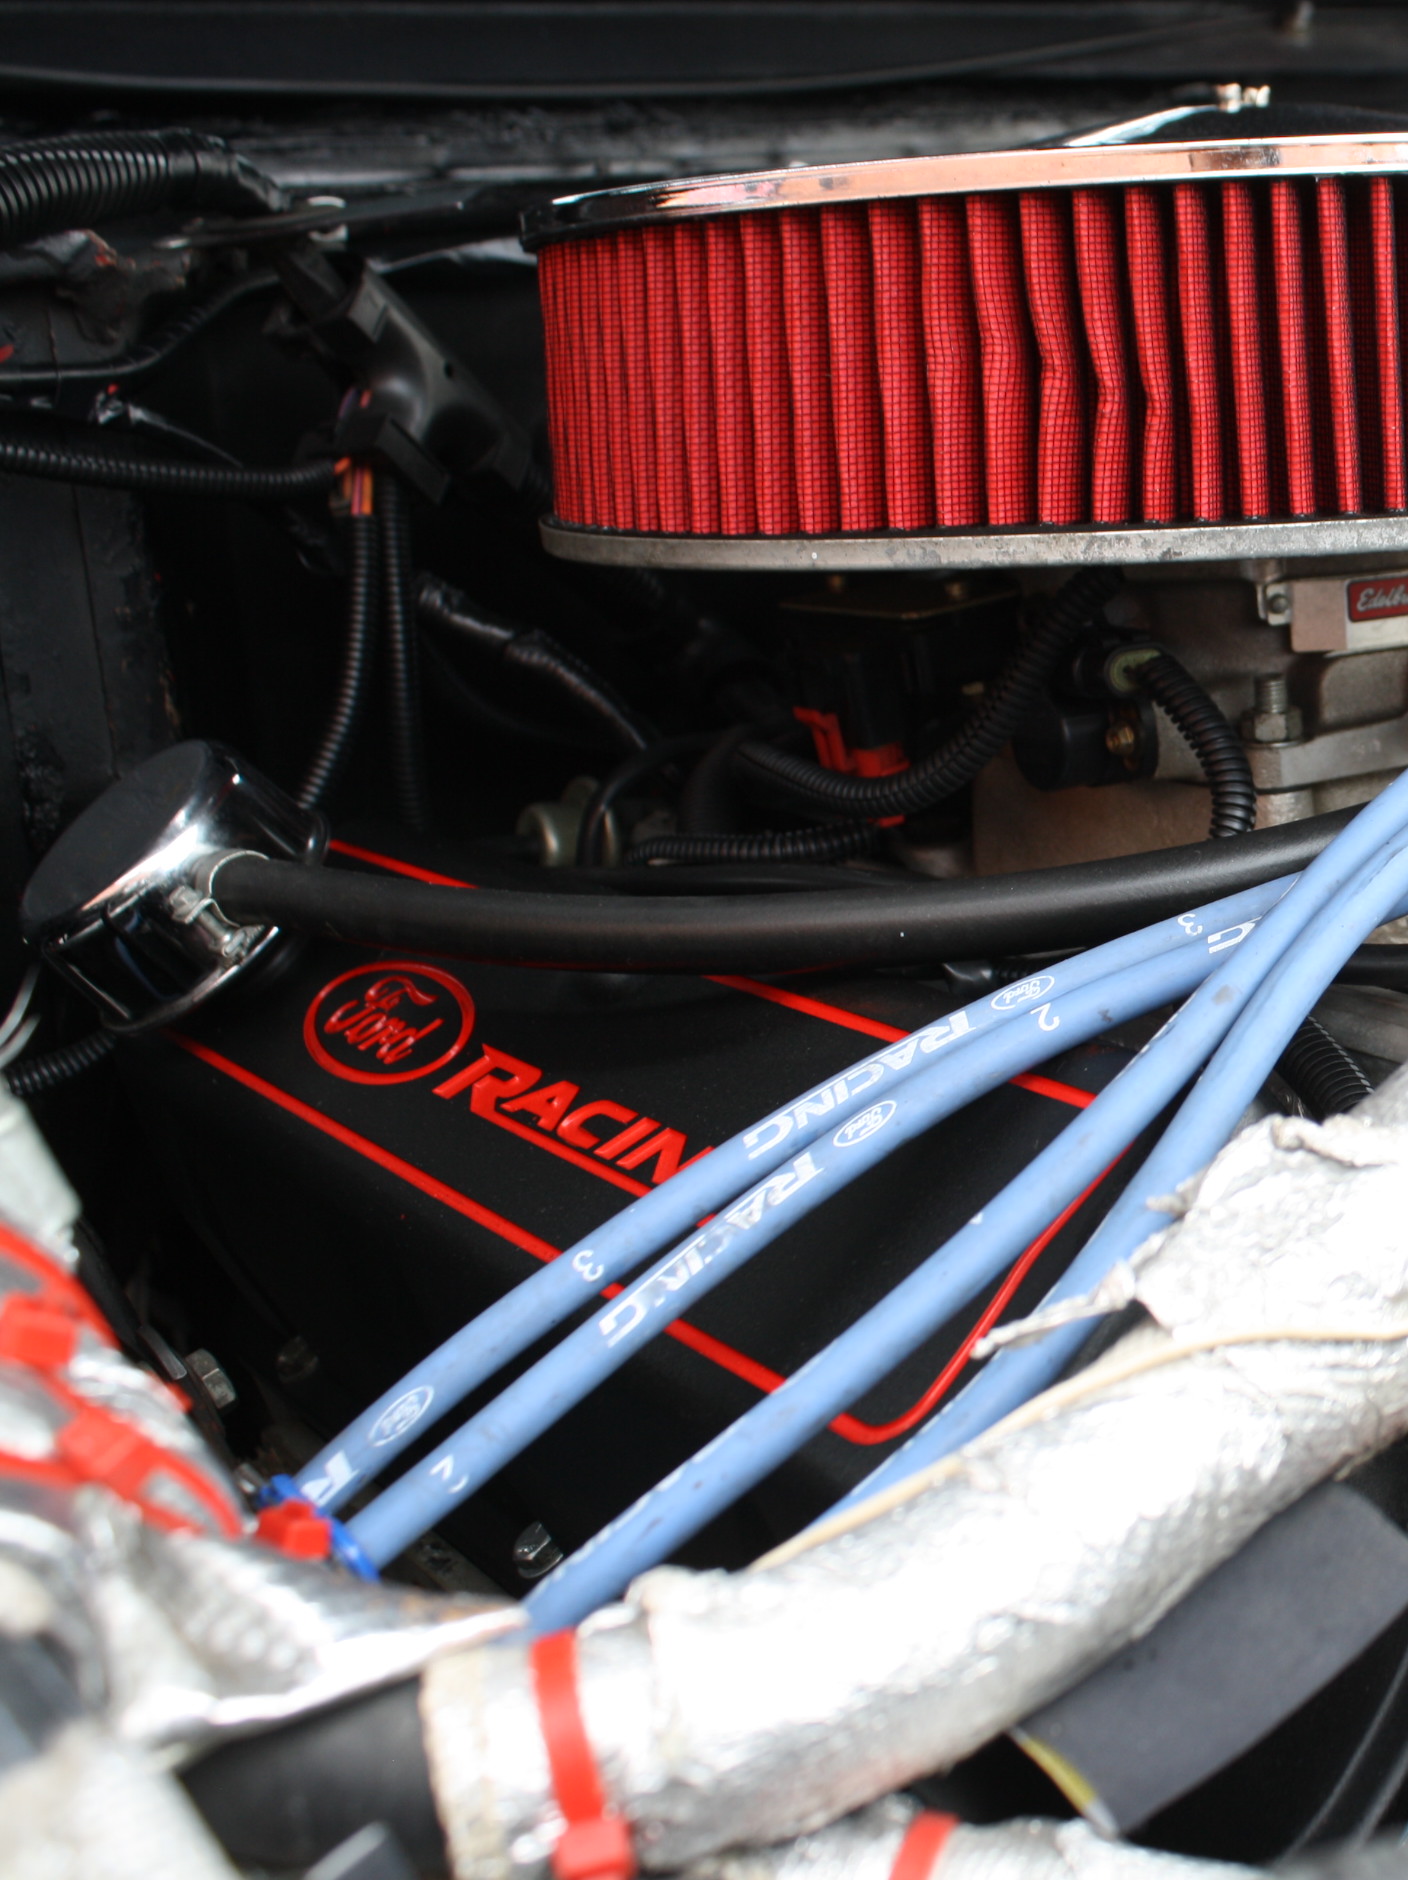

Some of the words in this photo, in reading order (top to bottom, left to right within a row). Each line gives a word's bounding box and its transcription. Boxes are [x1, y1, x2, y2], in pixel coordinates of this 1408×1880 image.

[1177, 913, 1203, 937] 3
[1029, 1002, 1061, 1032] 2
[742, 1009, 979, 1160] RACING
[431, 1043, 717, 1190] RACIN
[571, 1248, 605, 1283] 3
